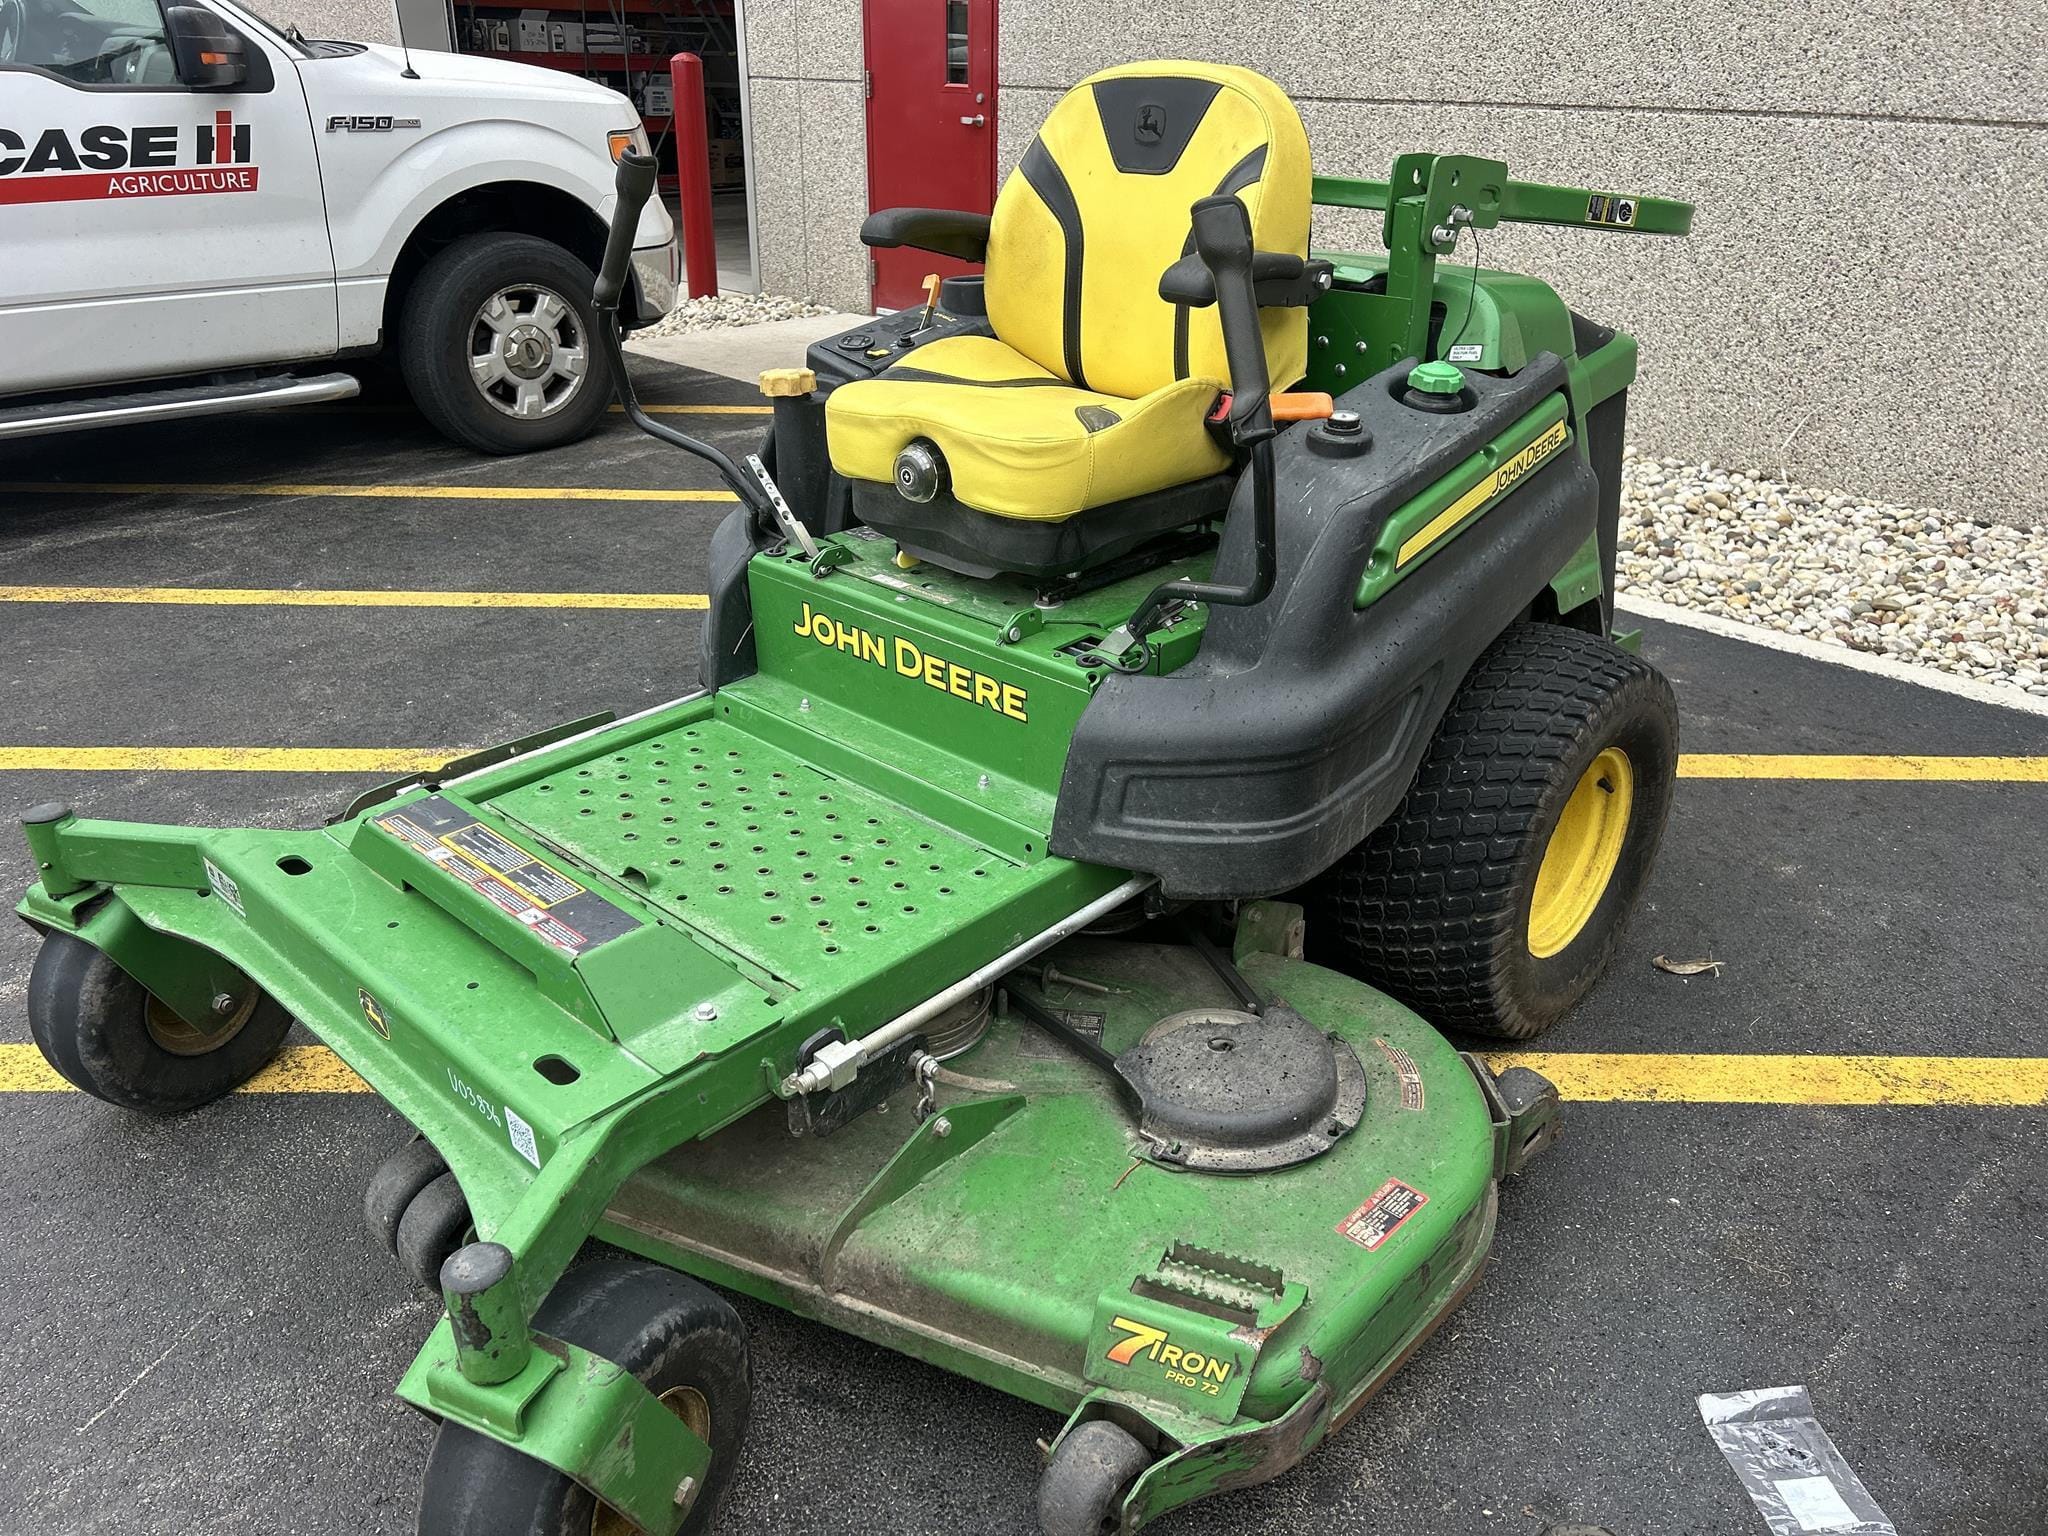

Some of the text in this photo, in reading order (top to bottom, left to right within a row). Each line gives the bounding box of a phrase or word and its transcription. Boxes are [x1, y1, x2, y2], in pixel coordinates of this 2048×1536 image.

[325, 115, 394, 132] F-150
[108, 171, 252, 195] AGRICULTURE
[1491, 428, 1560, 495] JOHN DEERE
[792, 600, 1028, 724] JOHN DEERE
[1164, 1369, 1220, 1396] PRO 72
